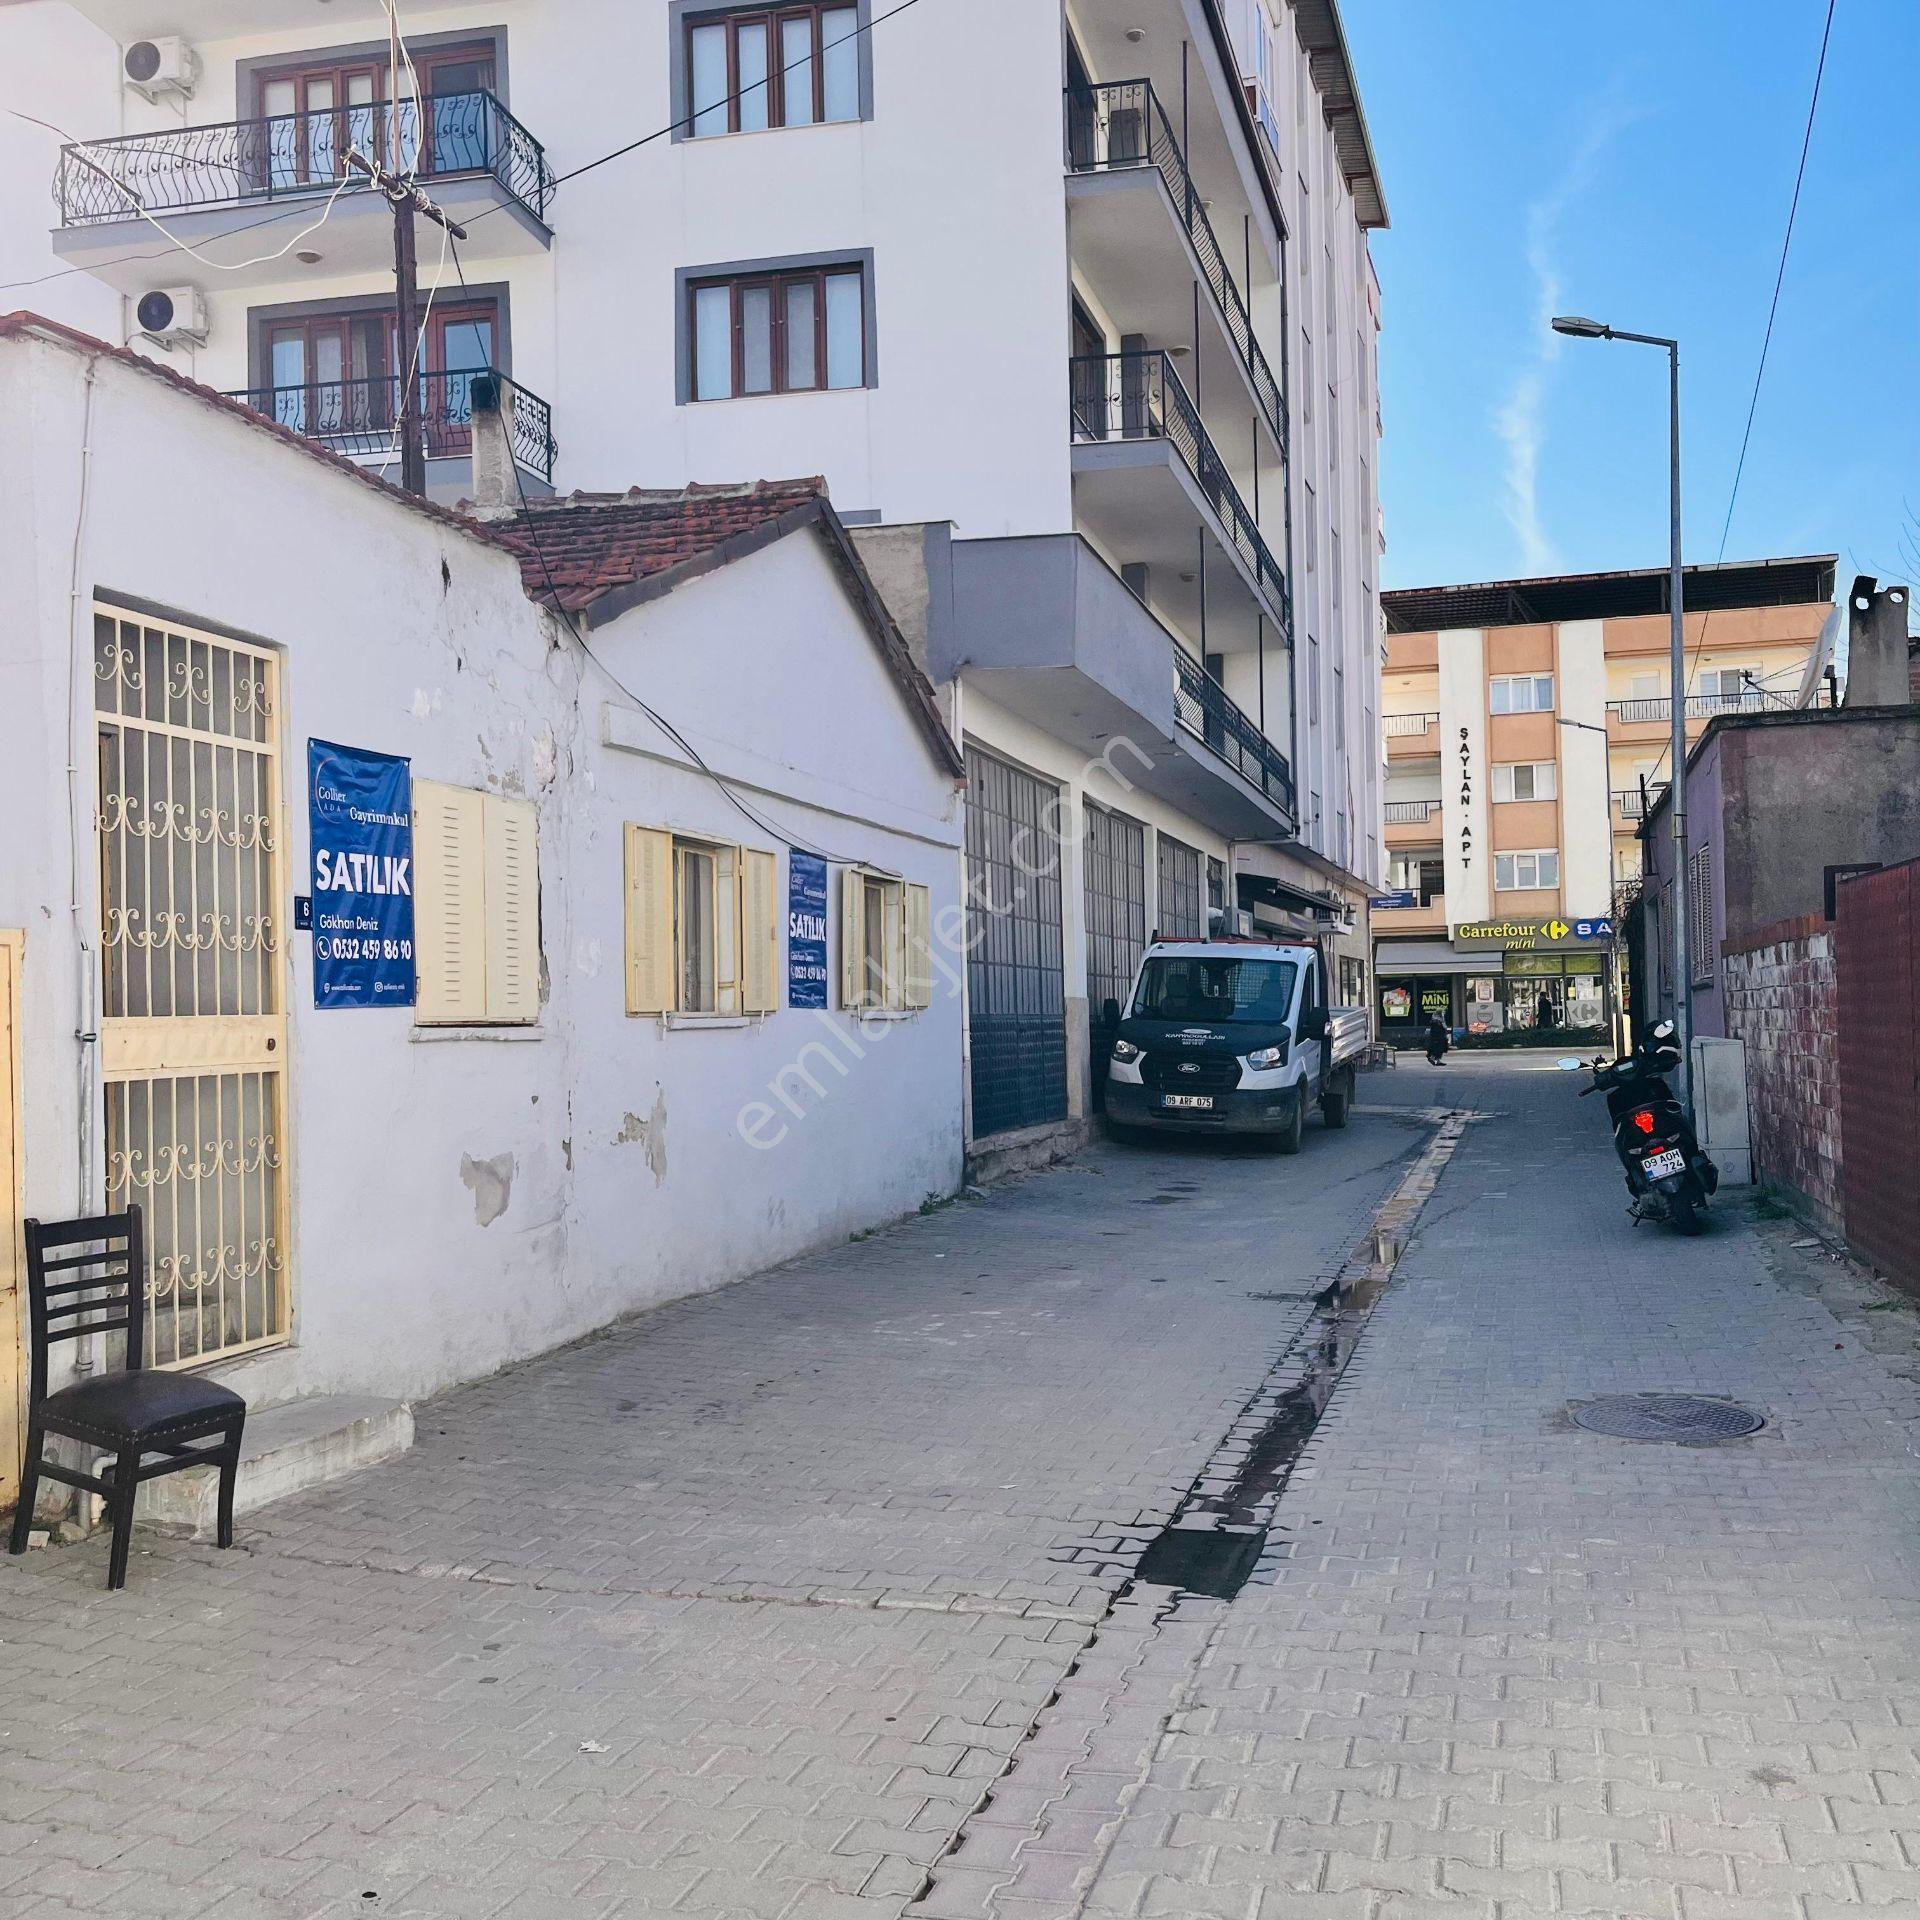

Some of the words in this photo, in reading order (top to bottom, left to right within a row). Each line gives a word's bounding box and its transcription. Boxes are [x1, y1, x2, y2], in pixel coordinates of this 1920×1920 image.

[1459, 727, 1472, 806] ŞAYLAN
[318, 786, 346, 803] Collier
[1461, 826, 1472, 869] APT
[316, 848, 411, 896] SATILIK
[303, 901, 310, 917] 6
[320, 914, 355, 930] Gökhan
[356, 916, 379, 931] Deniz
[789, 912, 826, 942] SATILIK
[1459, 922, 1536, 939] Carrefour
[332, 938, 360, 960] 0532
[361, 939, 381, 960] 459
[383, 939, 399, 960] 86
[400, 939, 412, 960] 90
[1505, 937, 1536, 950] mini
[1166, 1096, 1176, 1105] 09
[1179, 1097, 1193, 1106] ARF
[1196, 1098, 1211, 1107] 075
[1644, 1158, 1658, 1168] 09
